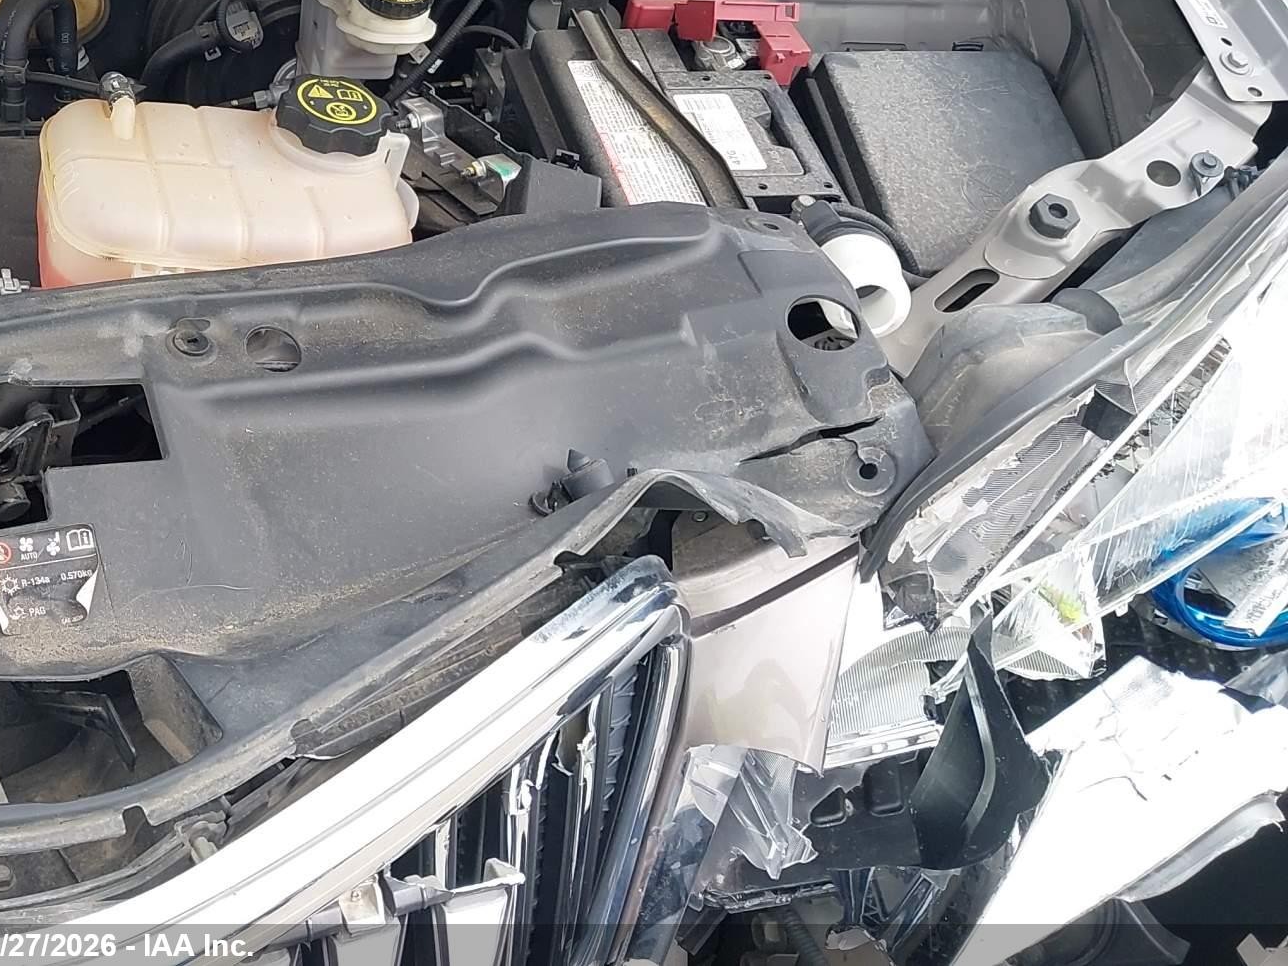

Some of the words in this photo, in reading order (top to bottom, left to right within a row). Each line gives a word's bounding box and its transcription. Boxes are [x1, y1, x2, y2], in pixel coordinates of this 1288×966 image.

[20, 552, 38, 561] AUTO
[21, 575, 51, 588] R-134a
[28, 606, 46, 618] PAG
